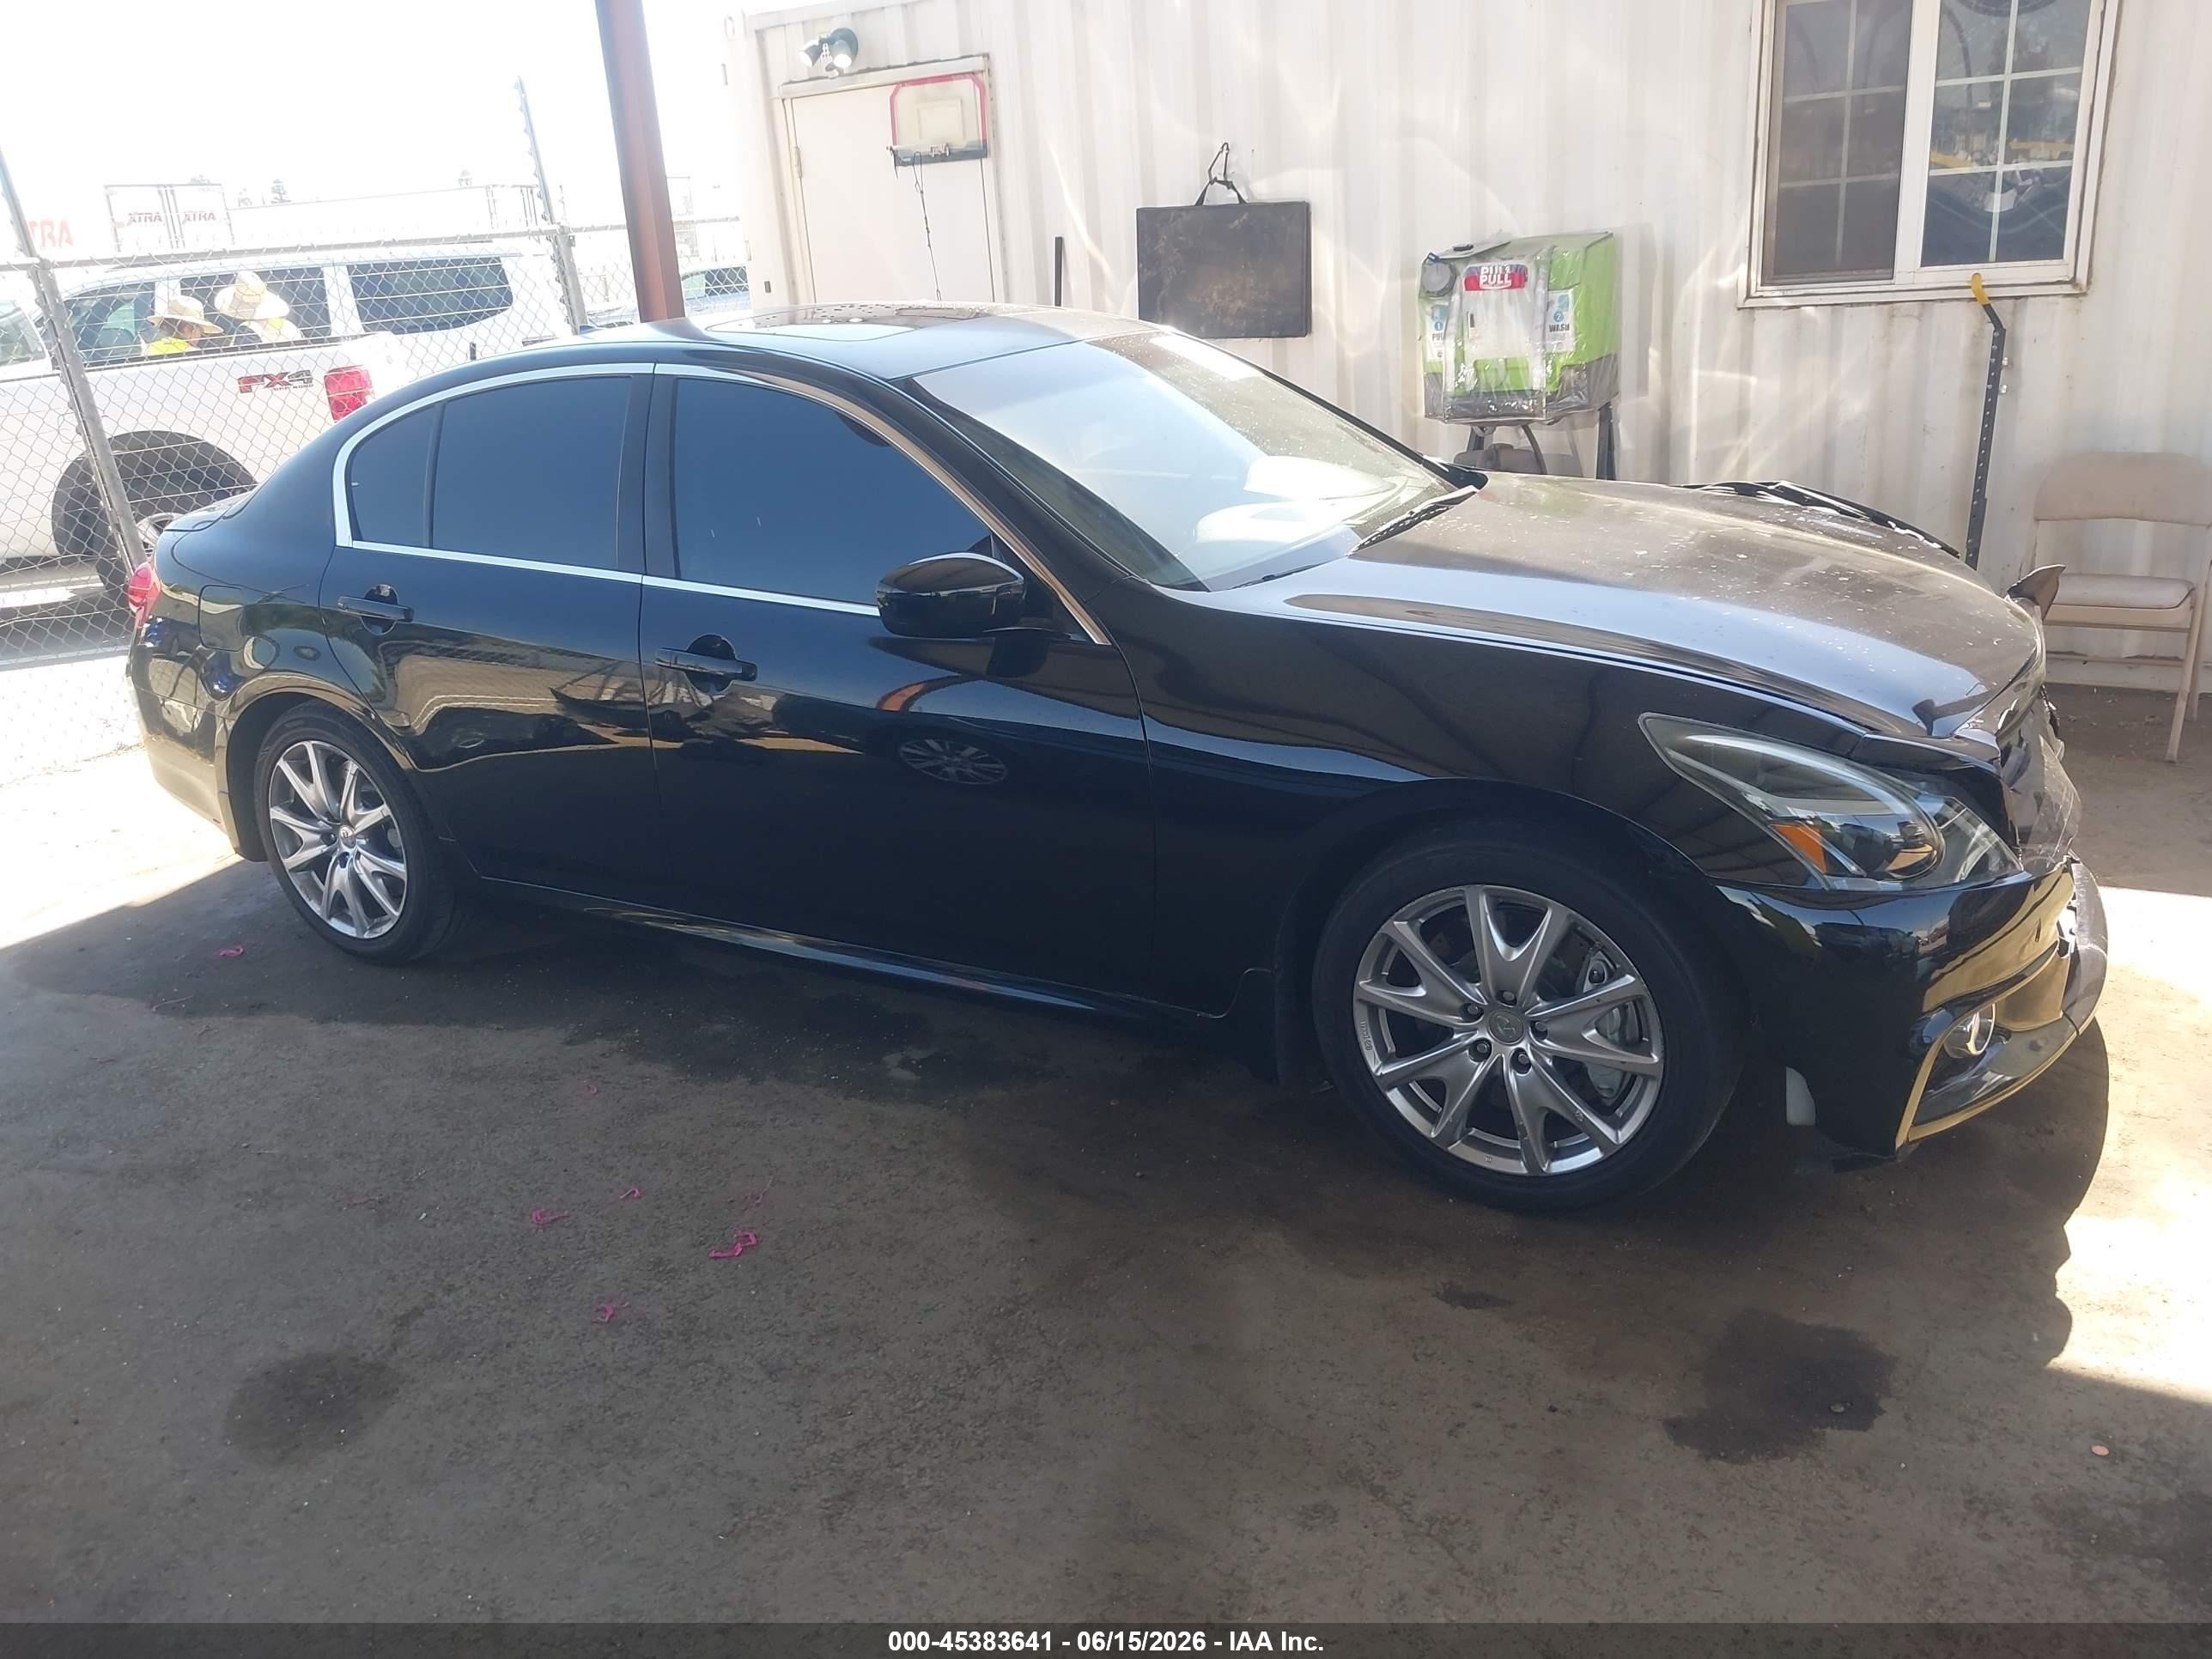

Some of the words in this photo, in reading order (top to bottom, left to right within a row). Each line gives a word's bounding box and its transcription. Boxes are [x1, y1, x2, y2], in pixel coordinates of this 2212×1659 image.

[126, 210, 163, 226] XTRA
[182, 210, 216, 225] XTRA
[1480, 274, 1511, 284] PULL
[237, 369, 313, 393] FX4
